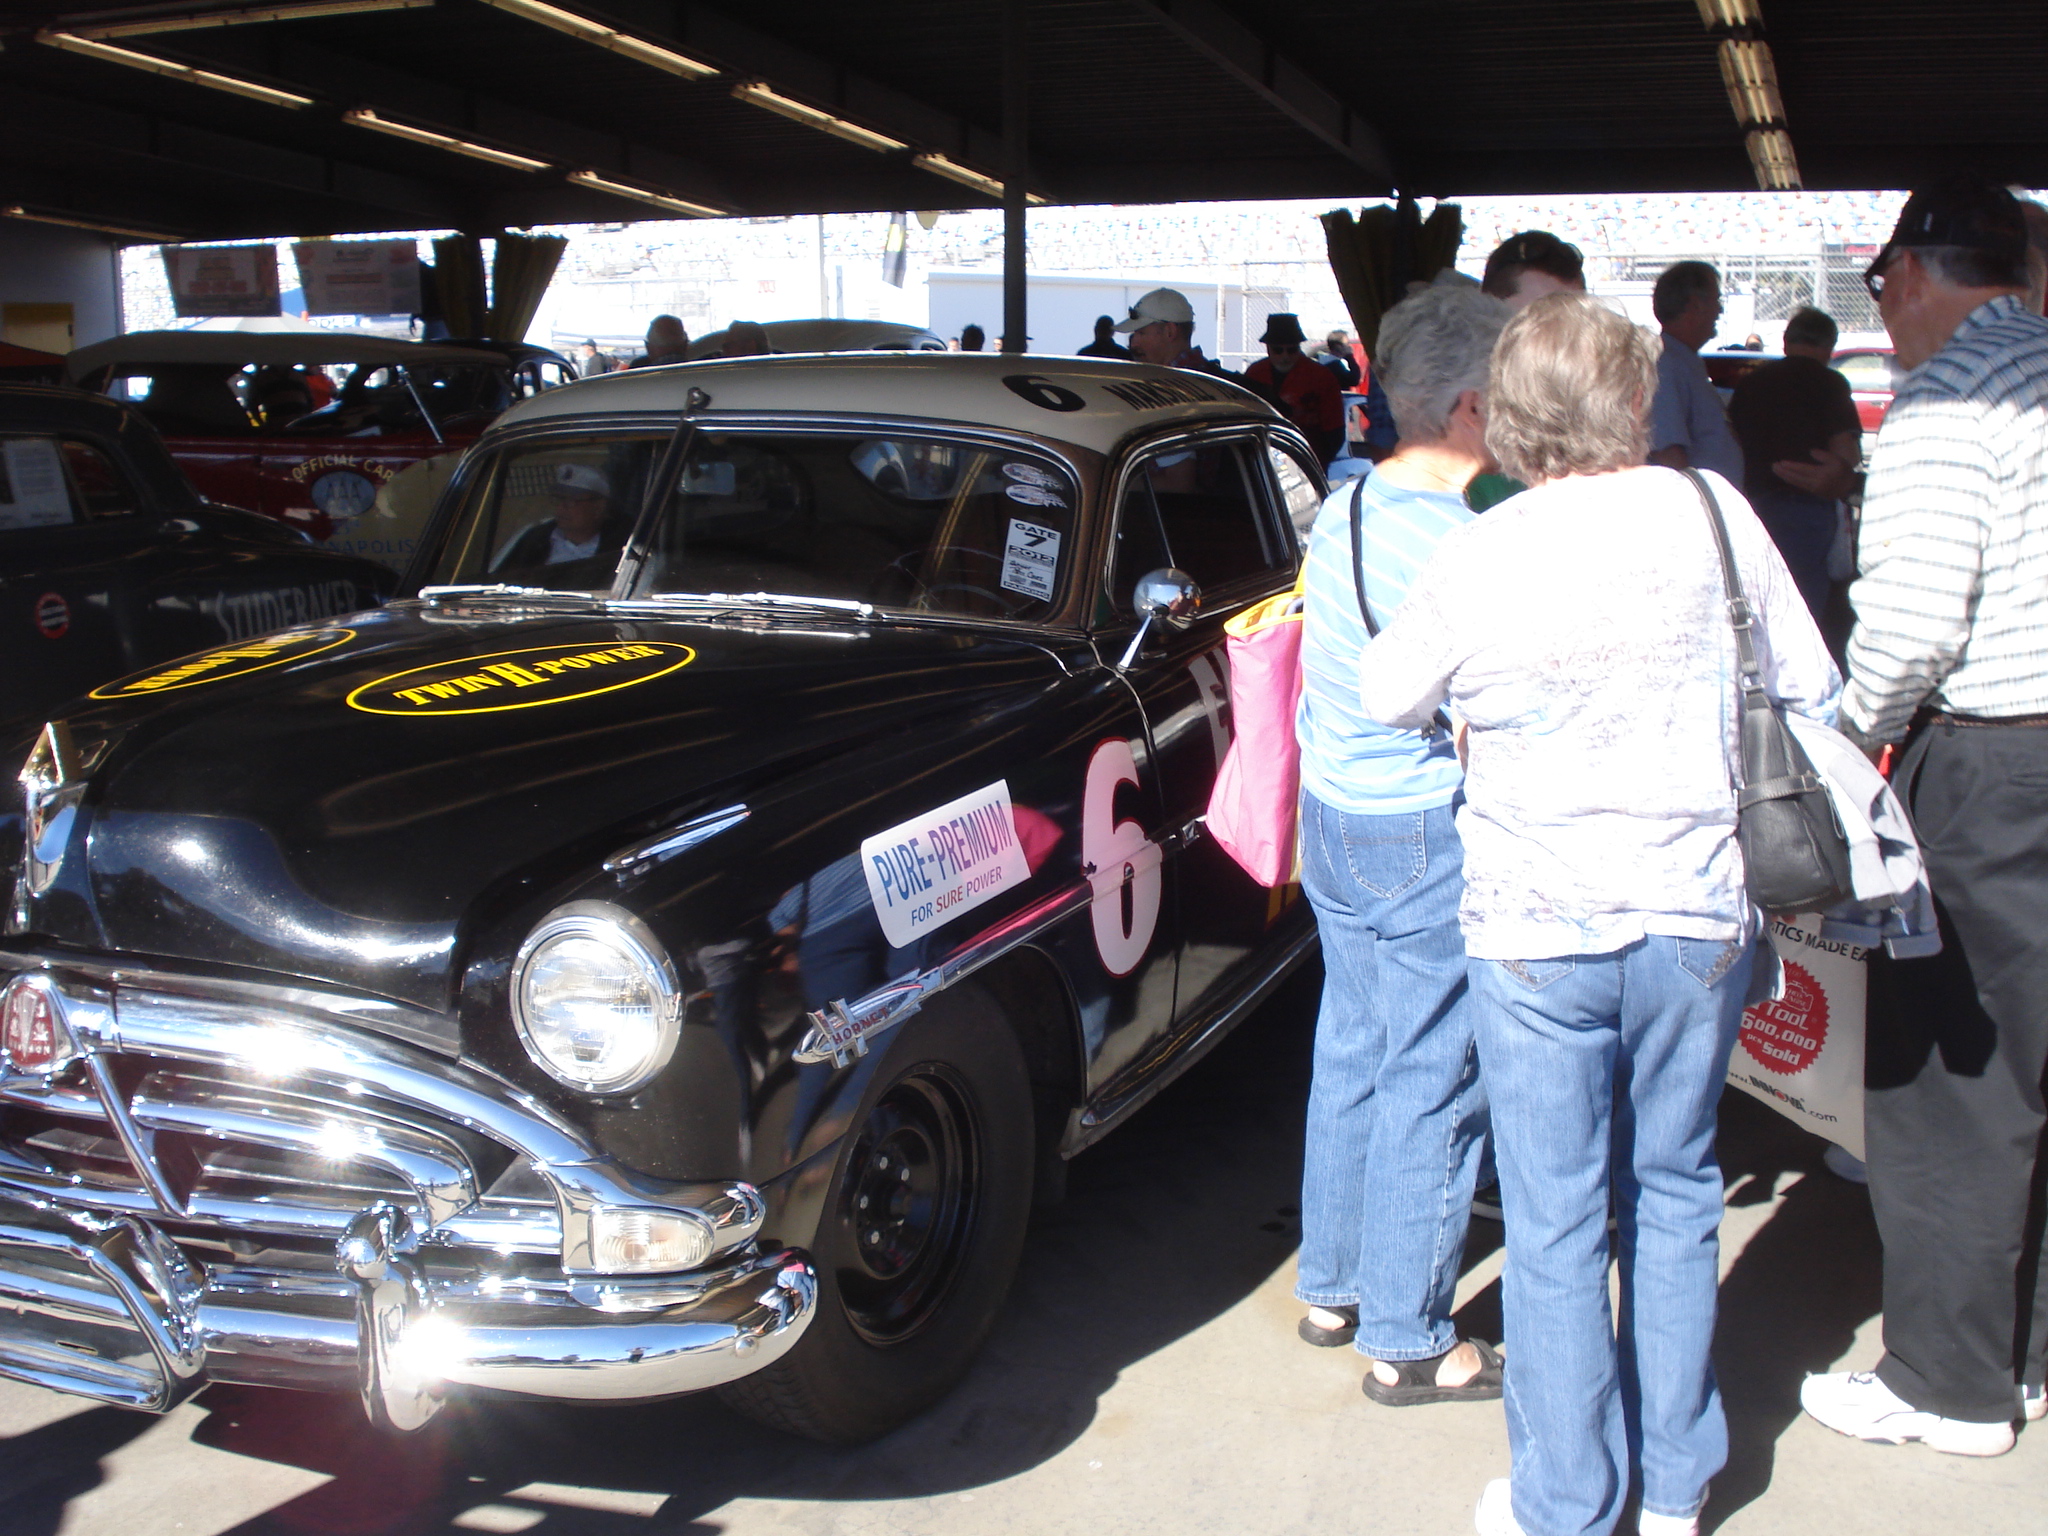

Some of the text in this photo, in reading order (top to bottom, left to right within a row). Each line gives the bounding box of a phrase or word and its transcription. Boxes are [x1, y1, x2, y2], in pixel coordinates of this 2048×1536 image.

[1002, 375, 1086, 412] 6
[292, 454, 394, 481] OFFICIAL CAR
[1015, 523, 1057, 540] GATE
[1024, 532, 1047, 547] 7
[393, 673, 503, 706] TWIN
[872, 800, 1012, 907] PURE-PREMIUM
[1083, 737, 1162, 978] 6
[911, 866, 1002, 926] FOR SURE POWER
[1805, 933, 1849, 957] MADE
[832, 1006, 889, 1045] HORNET
[1741, 1011, 1817, 1051] 600,000
[1762, 1044, 1801, 1066] Sold
